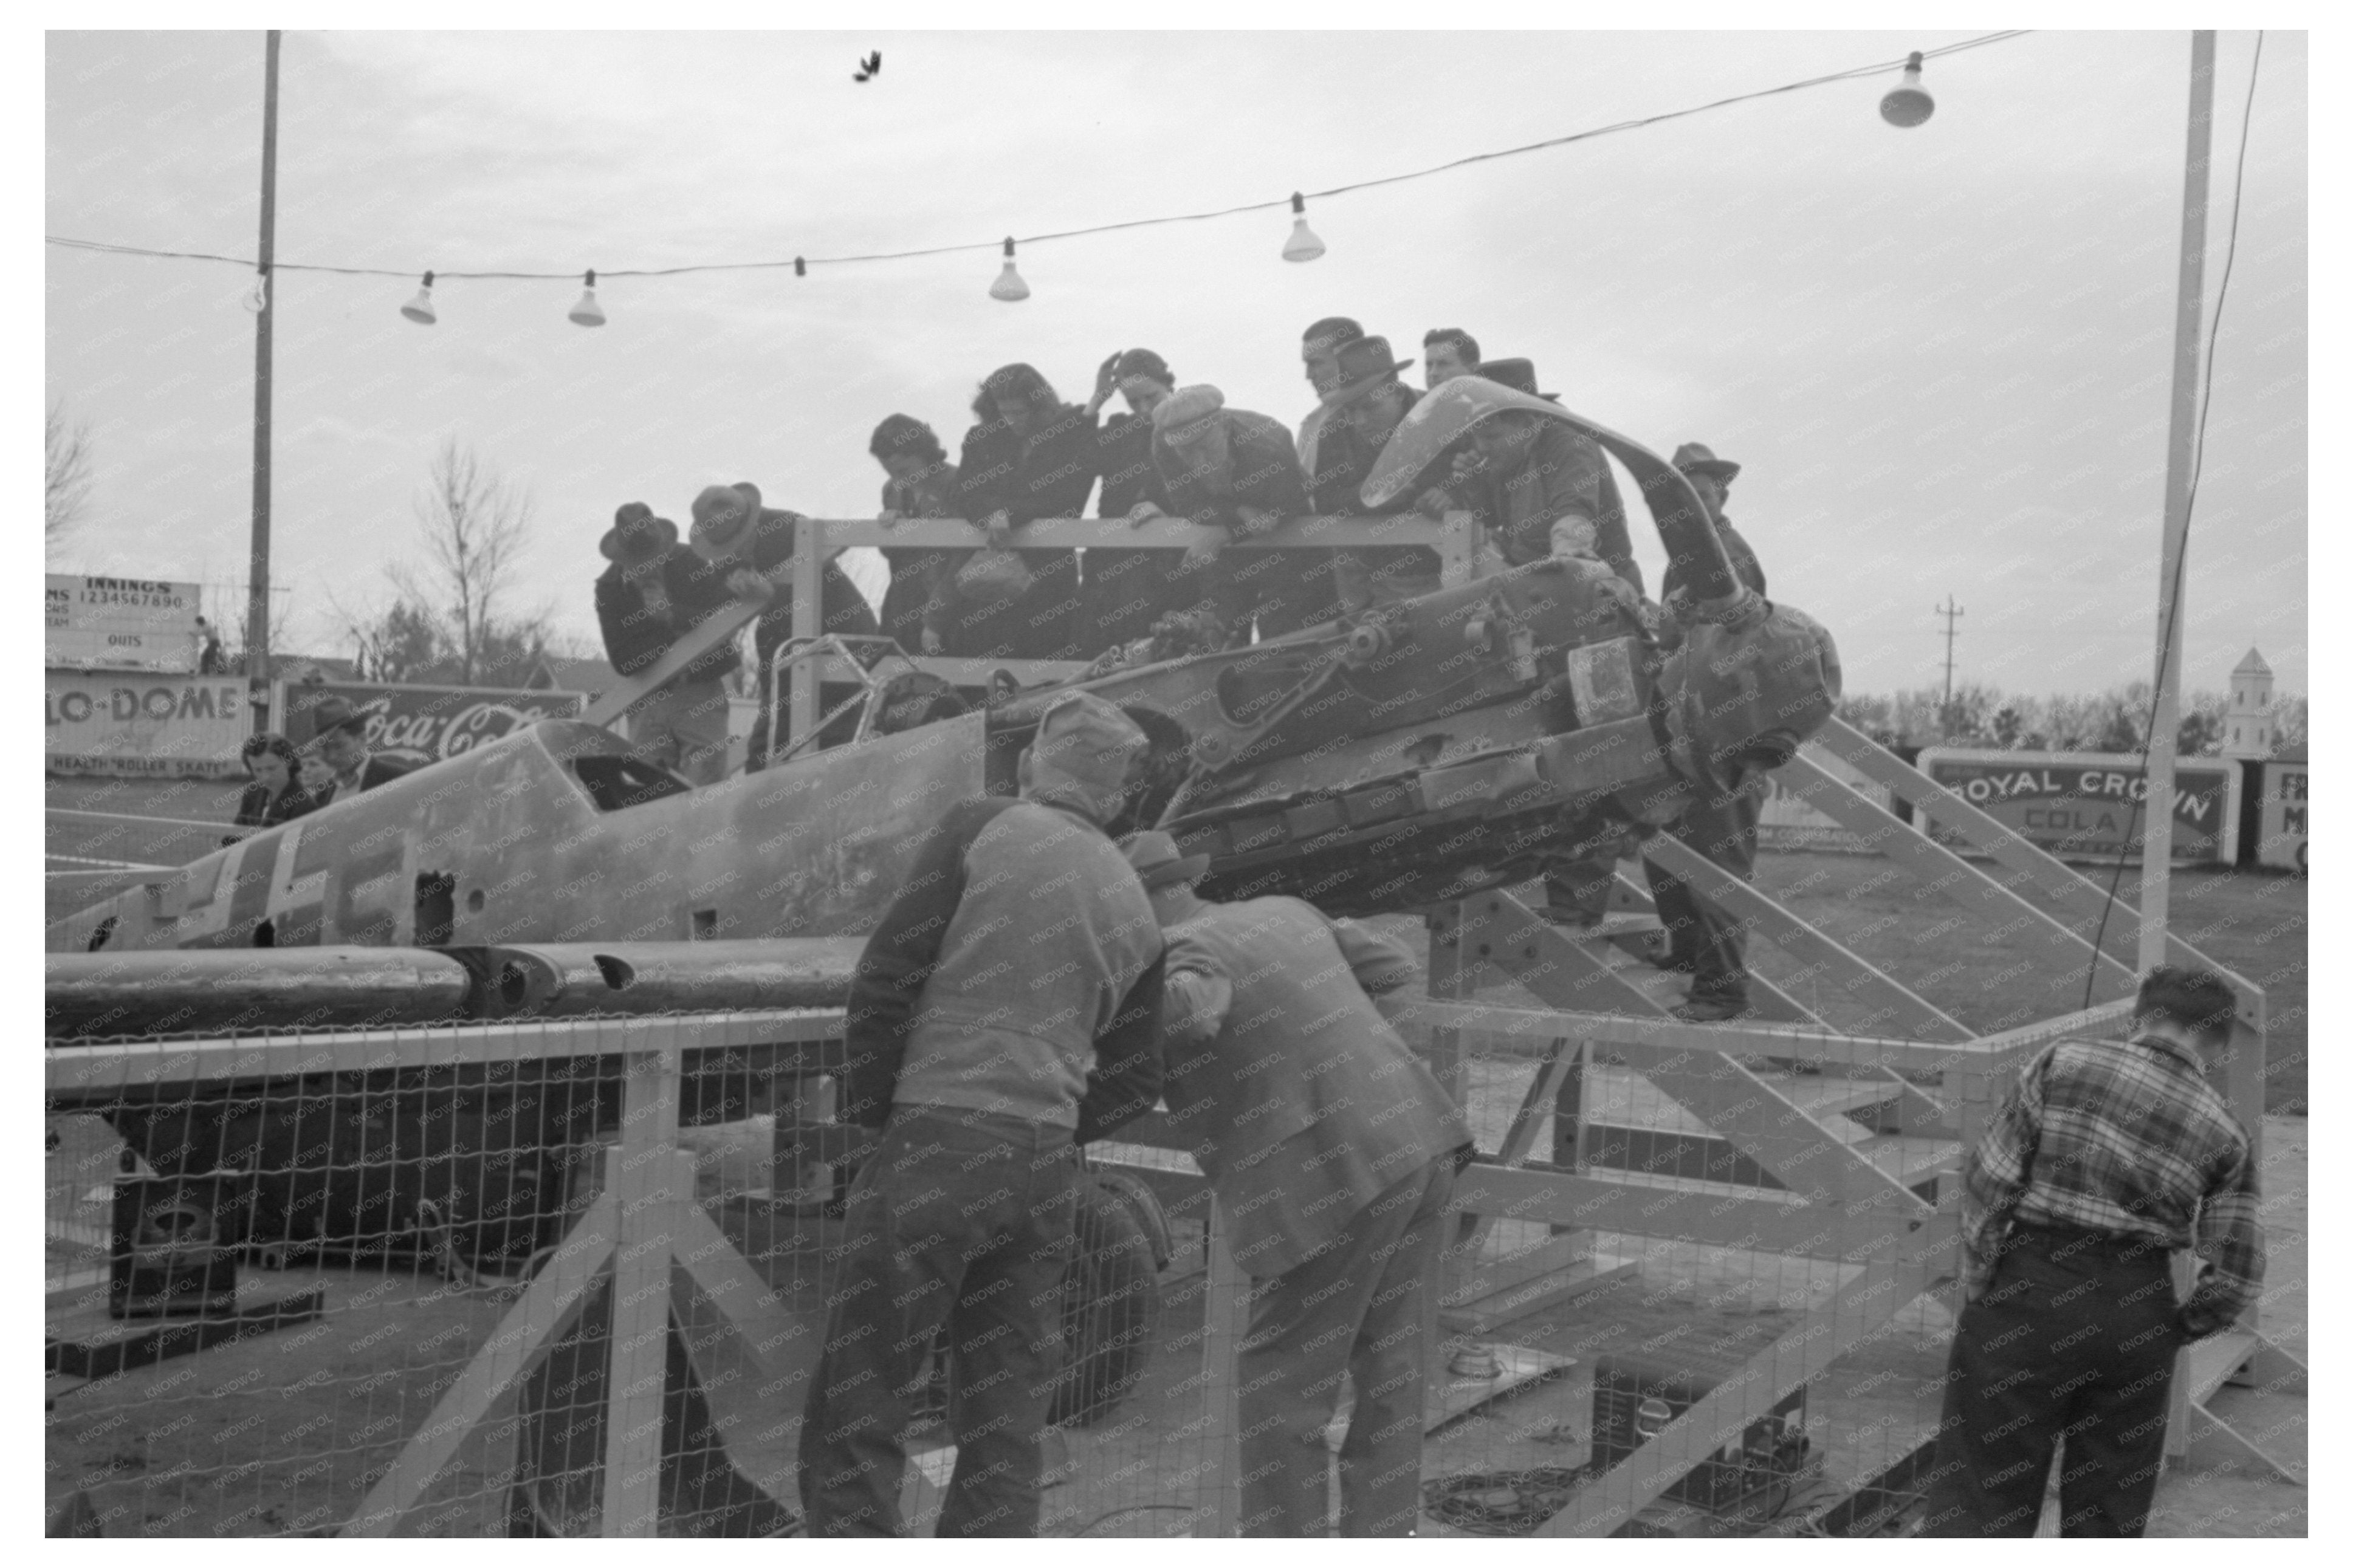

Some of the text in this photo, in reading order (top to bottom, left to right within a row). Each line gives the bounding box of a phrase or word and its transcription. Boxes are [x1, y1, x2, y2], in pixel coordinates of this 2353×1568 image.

[87, 578, 172, 594] INNINGS
[108, 634, 142, 647] OUTS
[55, 757, 108, 770] HEALTH
[2025, 808, 2118, 832] COLA
[2283, 806, 2307, 834] M
